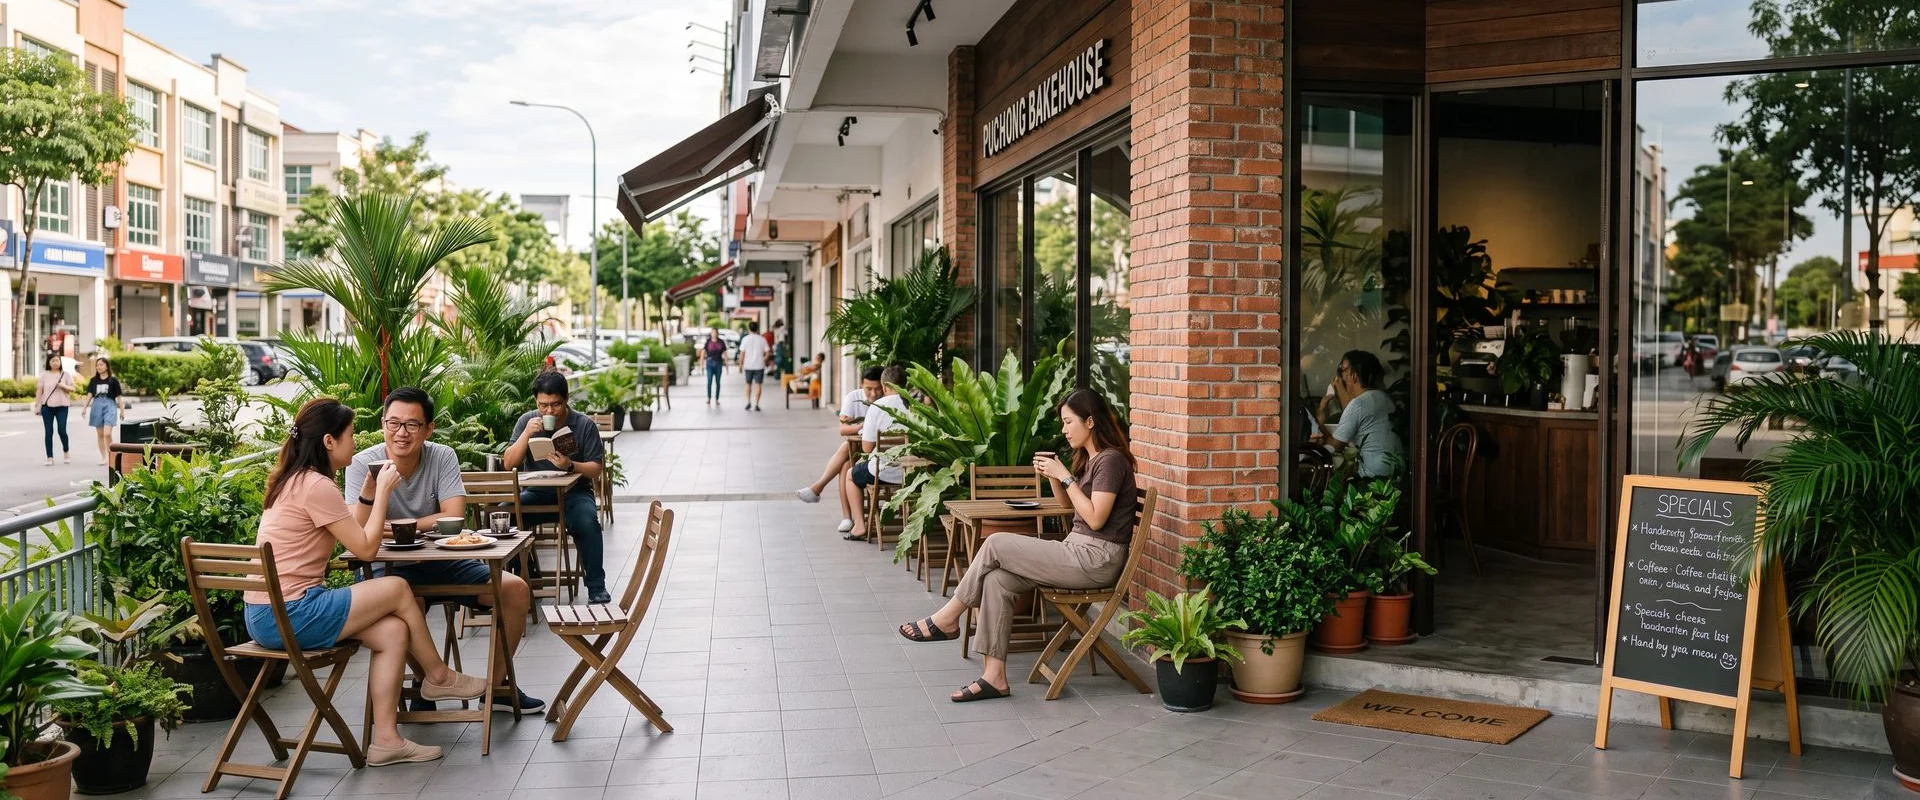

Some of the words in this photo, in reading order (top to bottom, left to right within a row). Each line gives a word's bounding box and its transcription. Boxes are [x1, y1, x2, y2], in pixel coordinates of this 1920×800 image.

[983, 97, 1026, 158] PUCHONG
[1028, 38, 1104, 131] BAKEHOUSE
[1657, 494, 1733, 518] SPECIALS
[1694, 584, 1711, 594] and
[1630, 634, 1654, 650] Hand
[1656, 639, 1668, 658] by
[1363, 702, 1510, 727] WELCOME
